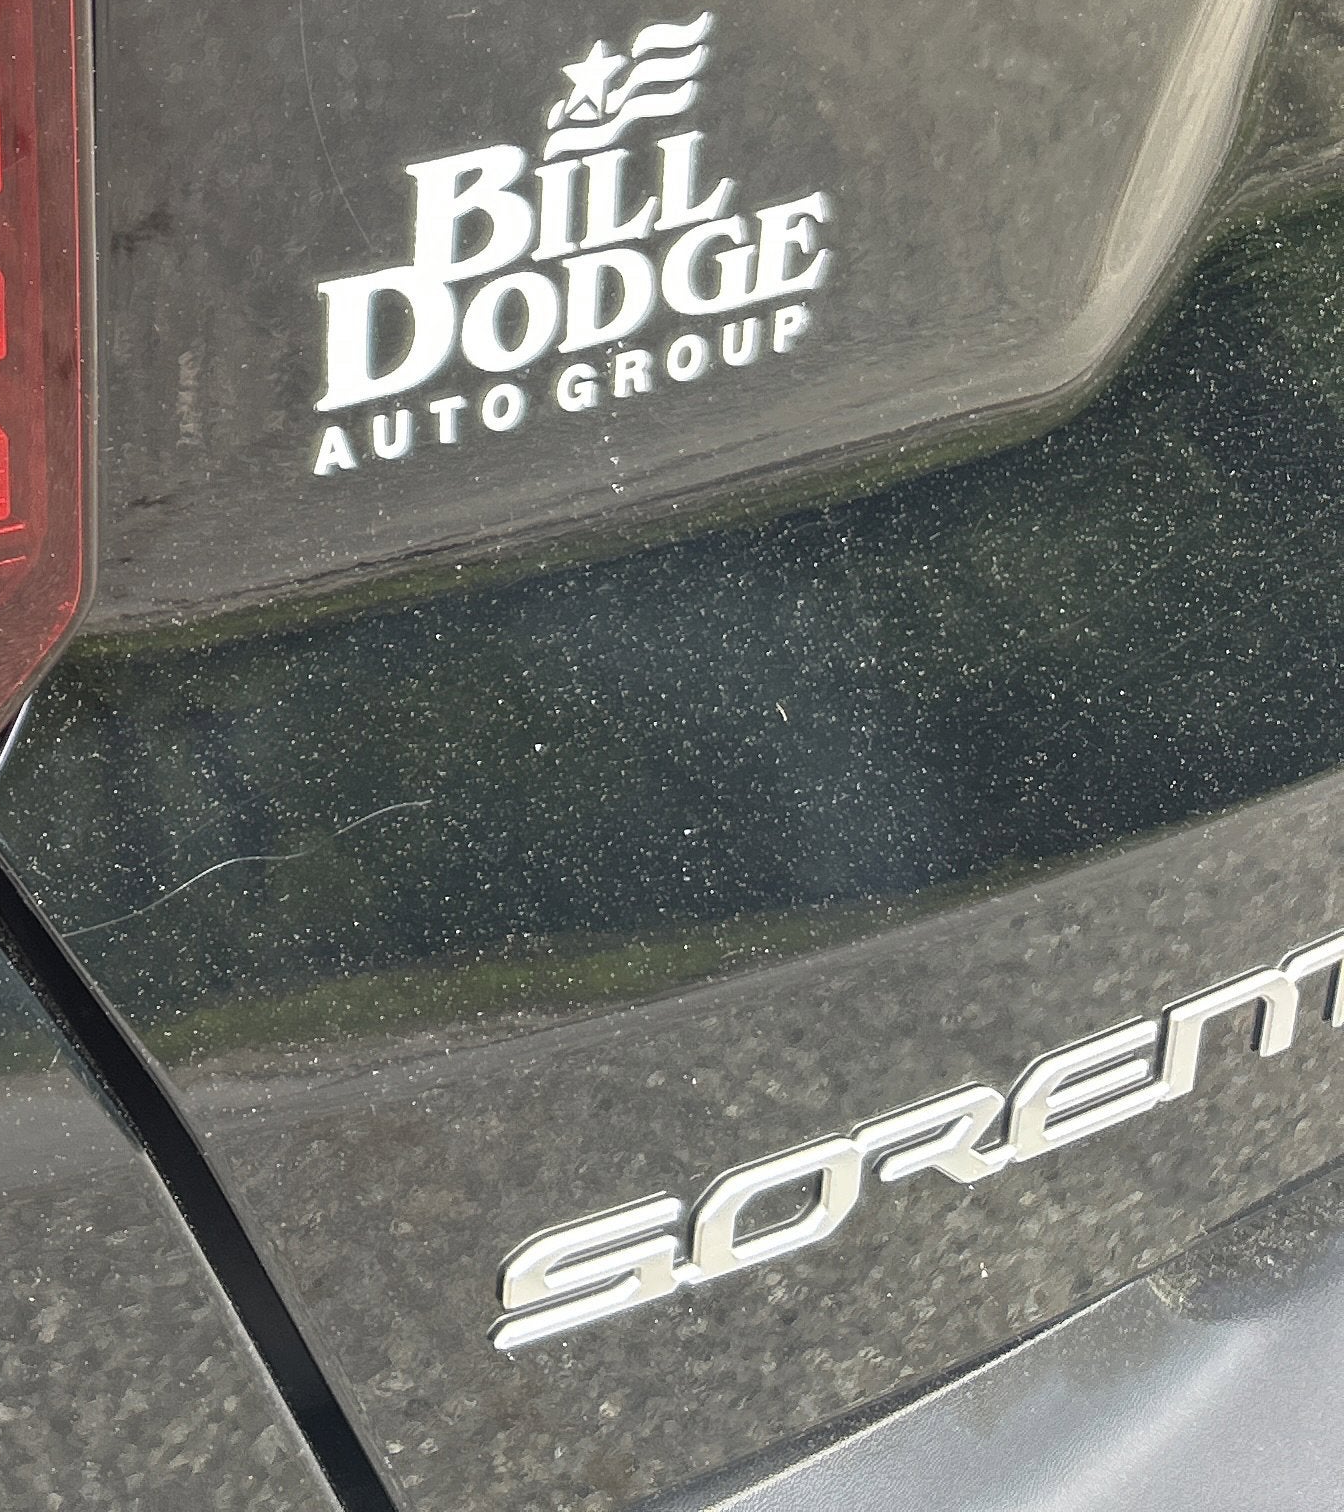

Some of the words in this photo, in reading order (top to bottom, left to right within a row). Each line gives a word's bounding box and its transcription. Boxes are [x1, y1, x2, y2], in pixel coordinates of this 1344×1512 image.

[405, 130, 737, 284] BILL
[314, 191, 831, 411] DODGE
[313, 383, 526, 476] AUTO
[556, 303, 812, 411] GROUP
